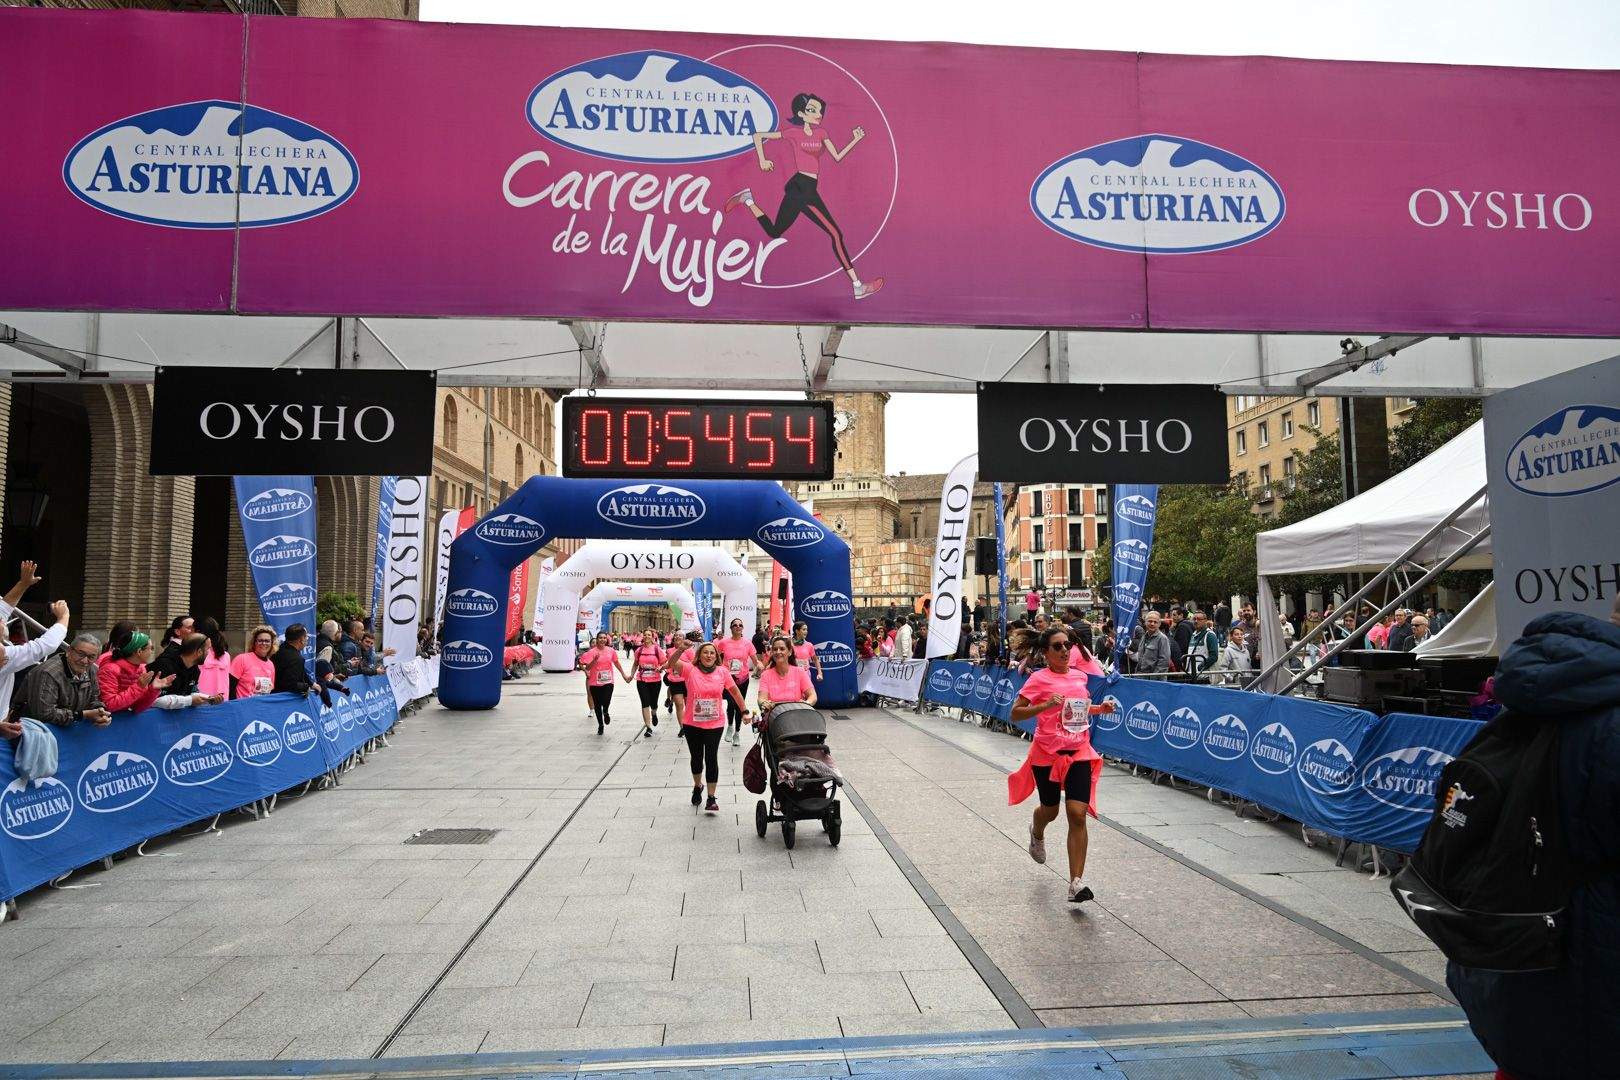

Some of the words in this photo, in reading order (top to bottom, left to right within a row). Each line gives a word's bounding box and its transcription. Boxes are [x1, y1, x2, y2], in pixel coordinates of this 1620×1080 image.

[586, 86, 665, 100] CENTRAL
[673, 90, 751, 104] LECHERA
[546, 88, 757, 136] ASTURIANA
[135, 144, 225, 156] CENTRAL
[234, 146, 328, 159] LECHERA
[86, 146, 336, 197] ASTURIANA
[502, 150, 711, 214] Carrera
[1090, 174, 1170, 187] CENTRAL
[1178, 176, 1258, 188] LECHERA
[1051, 176, 1267, 224] ASTURIANA
[1408, 188, 1593, 232] OYSHO
[552, 214, 592, 254] de
[600, 212, 629, 256] la
[621, 211, 788, 307] Mujer
[200, 402, 395, 443] OYSHO
[1019, 417, 1192, 454] OYSHO
[1534, 437, 1578, 454] CENTRAL
[605, 497, 698, 518] ASTURIANA
[479, 524, 540, 538] ASTURIANA
[763, 530, 820, 540] ASTURIANA
[389, 476, 422, 626] OYSHO
[610, 552, 694, 570] OYSHO
[935, 483, 970, 622] OYSHO
[877, 660, 914, 681] OYSHO
[1165, 720, 1198, 740] ASTURIANA
[1205, 728, 1244, 752] ASTURIANA
[243, 738, 280, 758] ASTURIANA
[170, 752, 230, 778] ASTURIANA
[85, 771, 154, 804] ASTURIANA
[6, 796, 70, 829] ASTURIANA
